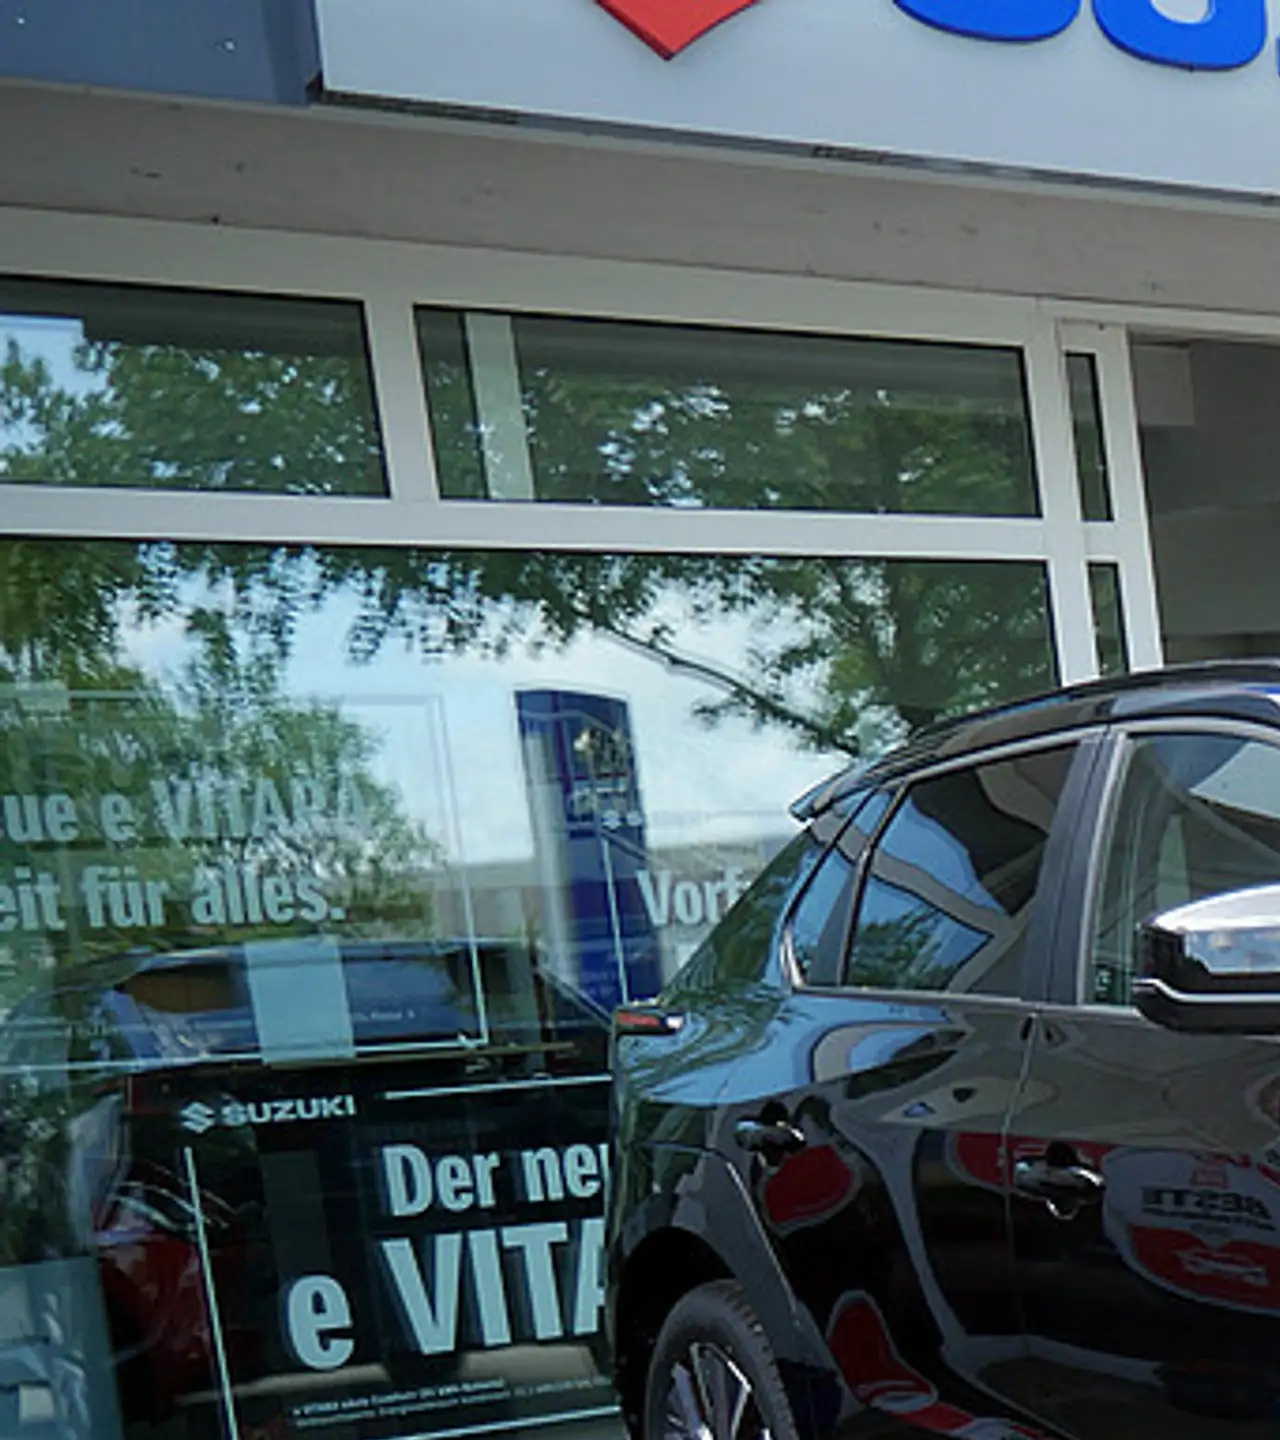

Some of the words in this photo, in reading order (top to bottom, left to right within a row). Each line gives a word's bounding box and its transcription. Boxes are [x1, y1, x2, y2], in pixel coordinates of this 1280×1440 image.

[0, 793, 79, 842] ue
[100, 793, 138, 842] e
[80, 865, 168, 927] für
[193, 855, 347, 926] alles.
[221, 1094, 357, 1128] SUZUKI
[382, 1143, 500, 1217] Der
[521, 1143, 609, 1203] ne
[288, 1274, 354, 1370] e
